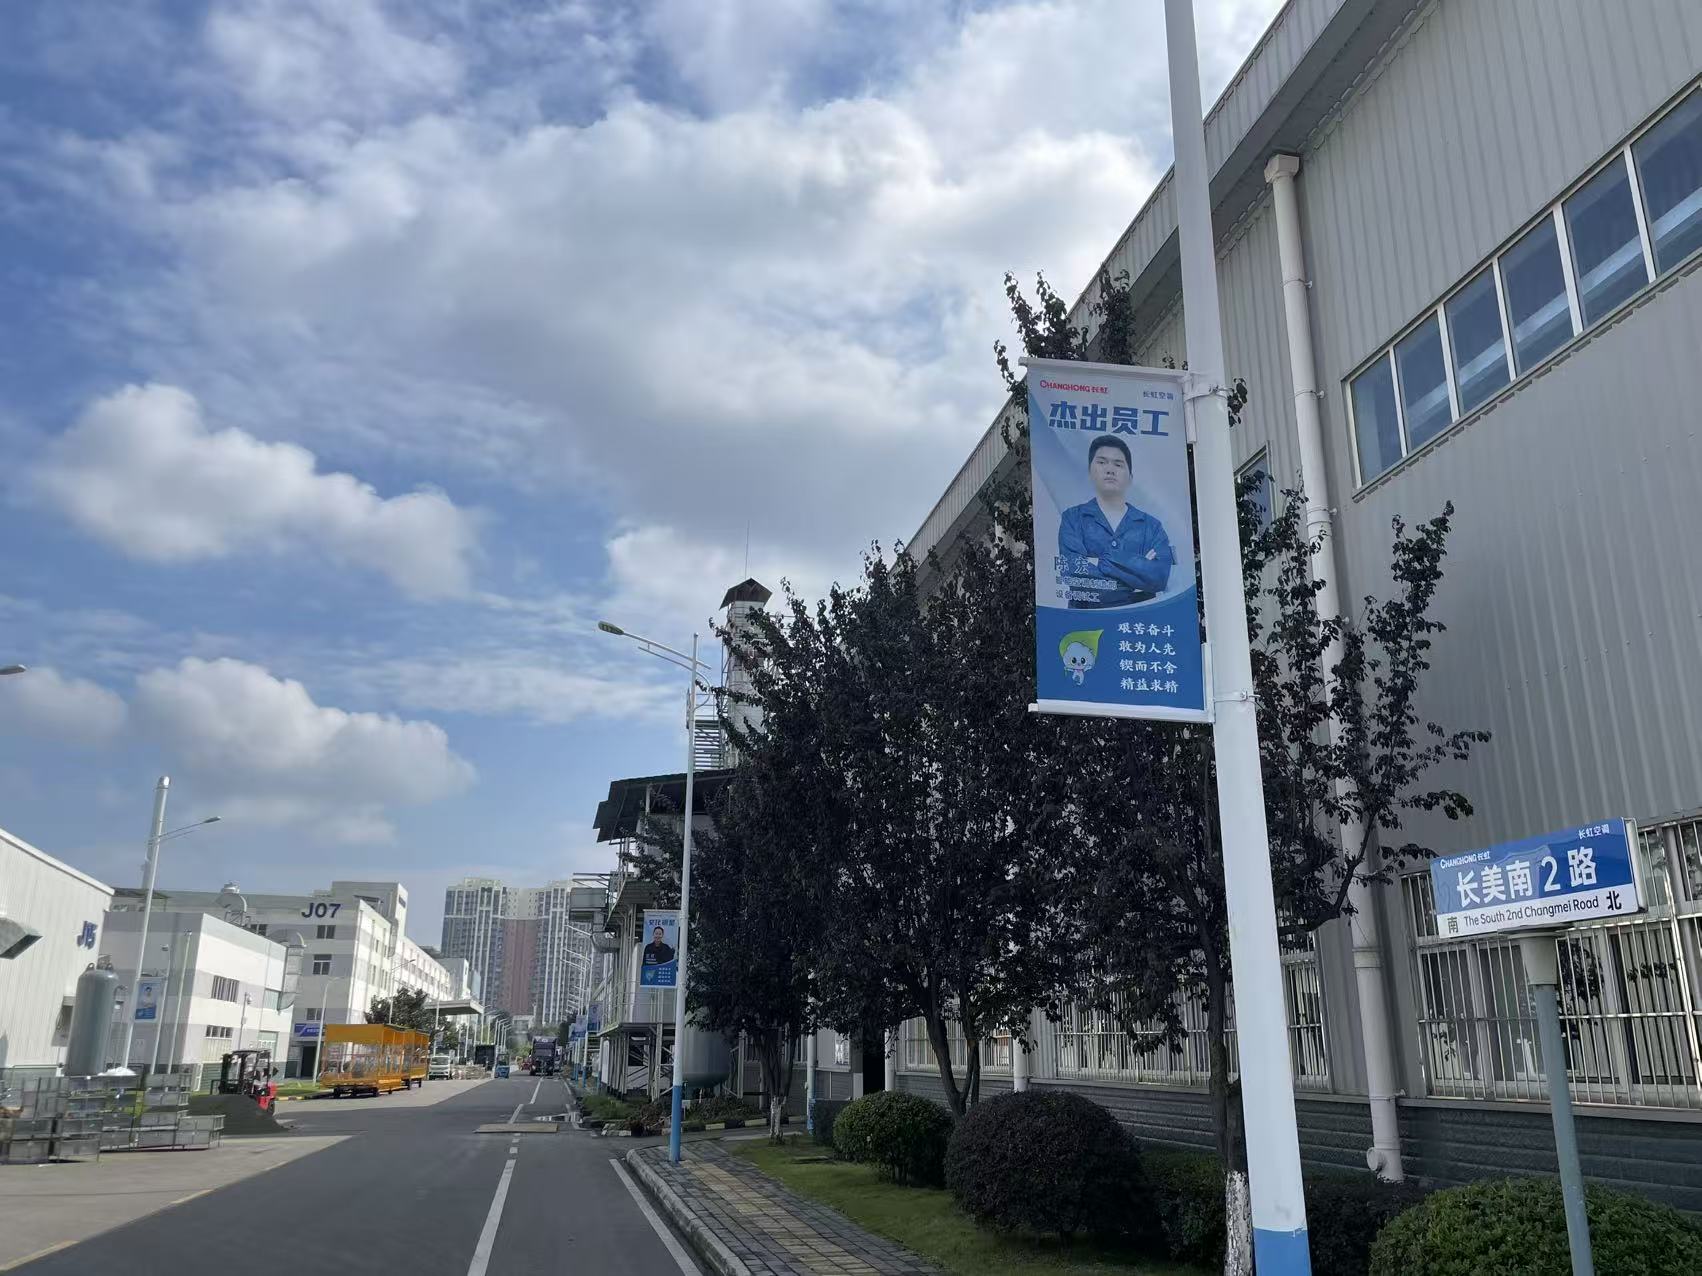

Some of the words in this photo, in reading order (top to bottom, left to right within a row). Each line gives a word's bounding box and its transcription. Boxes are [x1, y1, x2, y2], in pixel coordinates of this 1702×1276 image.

[1040, 380, 1090, 393] CHANGHONG
[1048, 400, 1169, 437] 杰出员工
[1117, 622, 1175, 637] 艰苦奋斗
[1119, 640, 1176, 656] 敢为人先
[1119, 659, 1178, 675] 锲而不舍
[1120, 677, 1179, 694] 精益求精
[1578, 823, 1610, 839] 长虹空调
[1440, 853, 1477, 869] CHANGHONG
[1606, 891, 1622, 911] 北
[301, 902, 341, 918] J07
[1464, 916, 1479, 927] The
[1480, 909, 1505, 925] South
[1506, 907, 1523, 921] 2nd
[1524, 900, 1572, 919] Changmei
[1573, 896, 1599, 911] Road
[1447, 916, 1459, 934] 南
